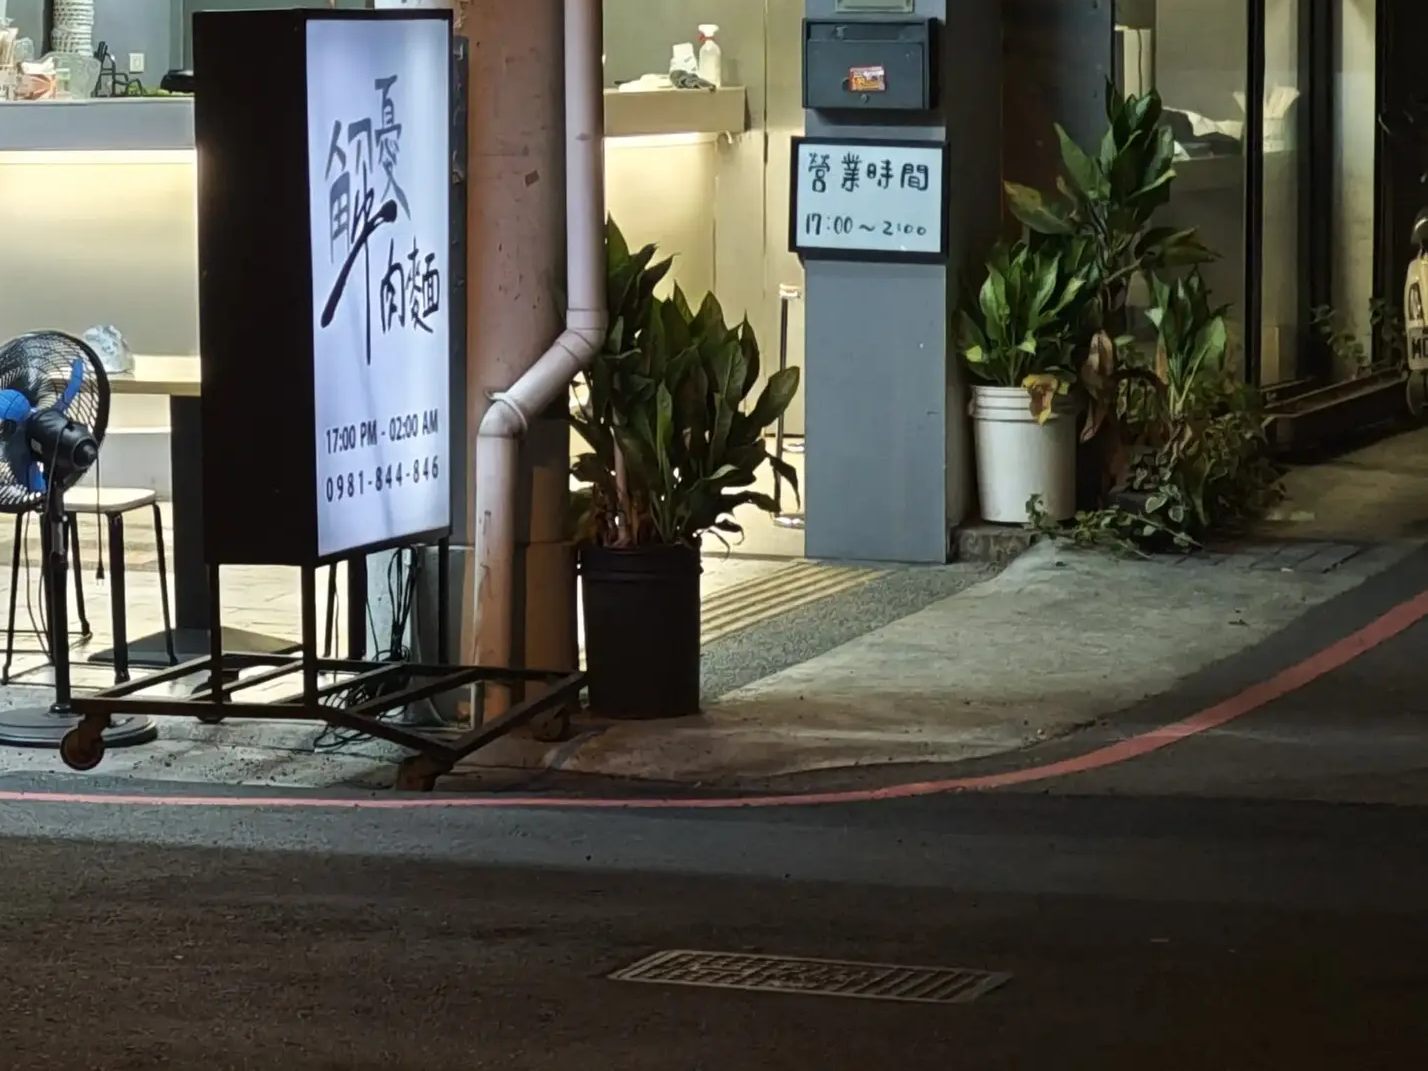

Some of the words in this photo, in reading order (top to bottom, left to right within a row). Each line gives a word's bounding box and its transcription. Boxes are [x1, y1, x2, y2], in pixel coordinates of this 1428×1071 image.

[808, 152, 929, 193] 營業時間
[326, 425, 356, 454] 17:00
[360, 419, 378, 448] PM
[389, 414, 418, 442] 02:00
[422, 410, 438, 435] AM
